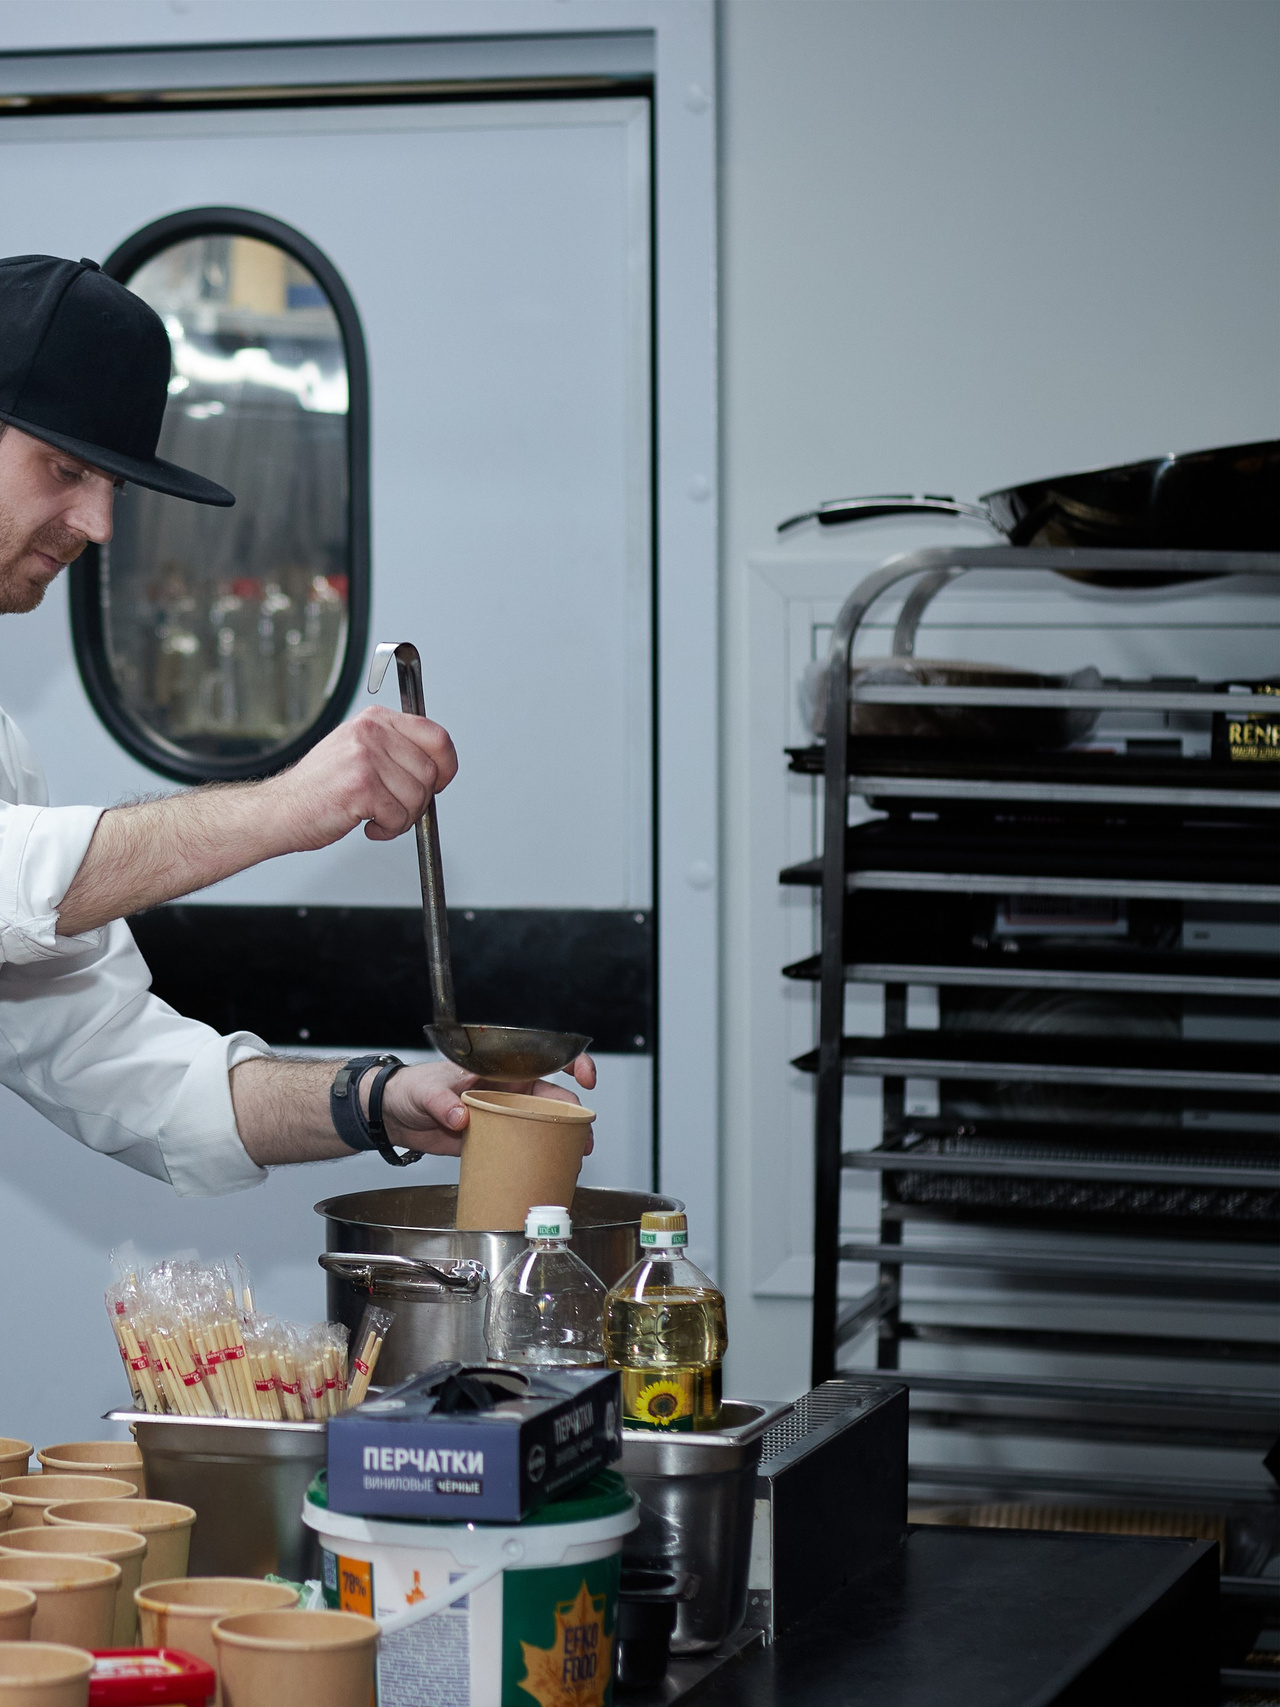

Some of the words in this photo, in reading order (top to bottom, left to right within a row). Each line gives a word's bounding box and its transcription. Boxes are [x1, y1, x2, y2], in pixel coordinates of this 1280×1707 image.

[553, 1401, 595, 1446] ПЕРЧАТКИ
[363, 1446, 484, 1475] ПЕРЧАТКИ
[363, 1474, 434, 1492] ВИНИЛОВЫЕ
[562, 1652, 598, 1685] FOOD
